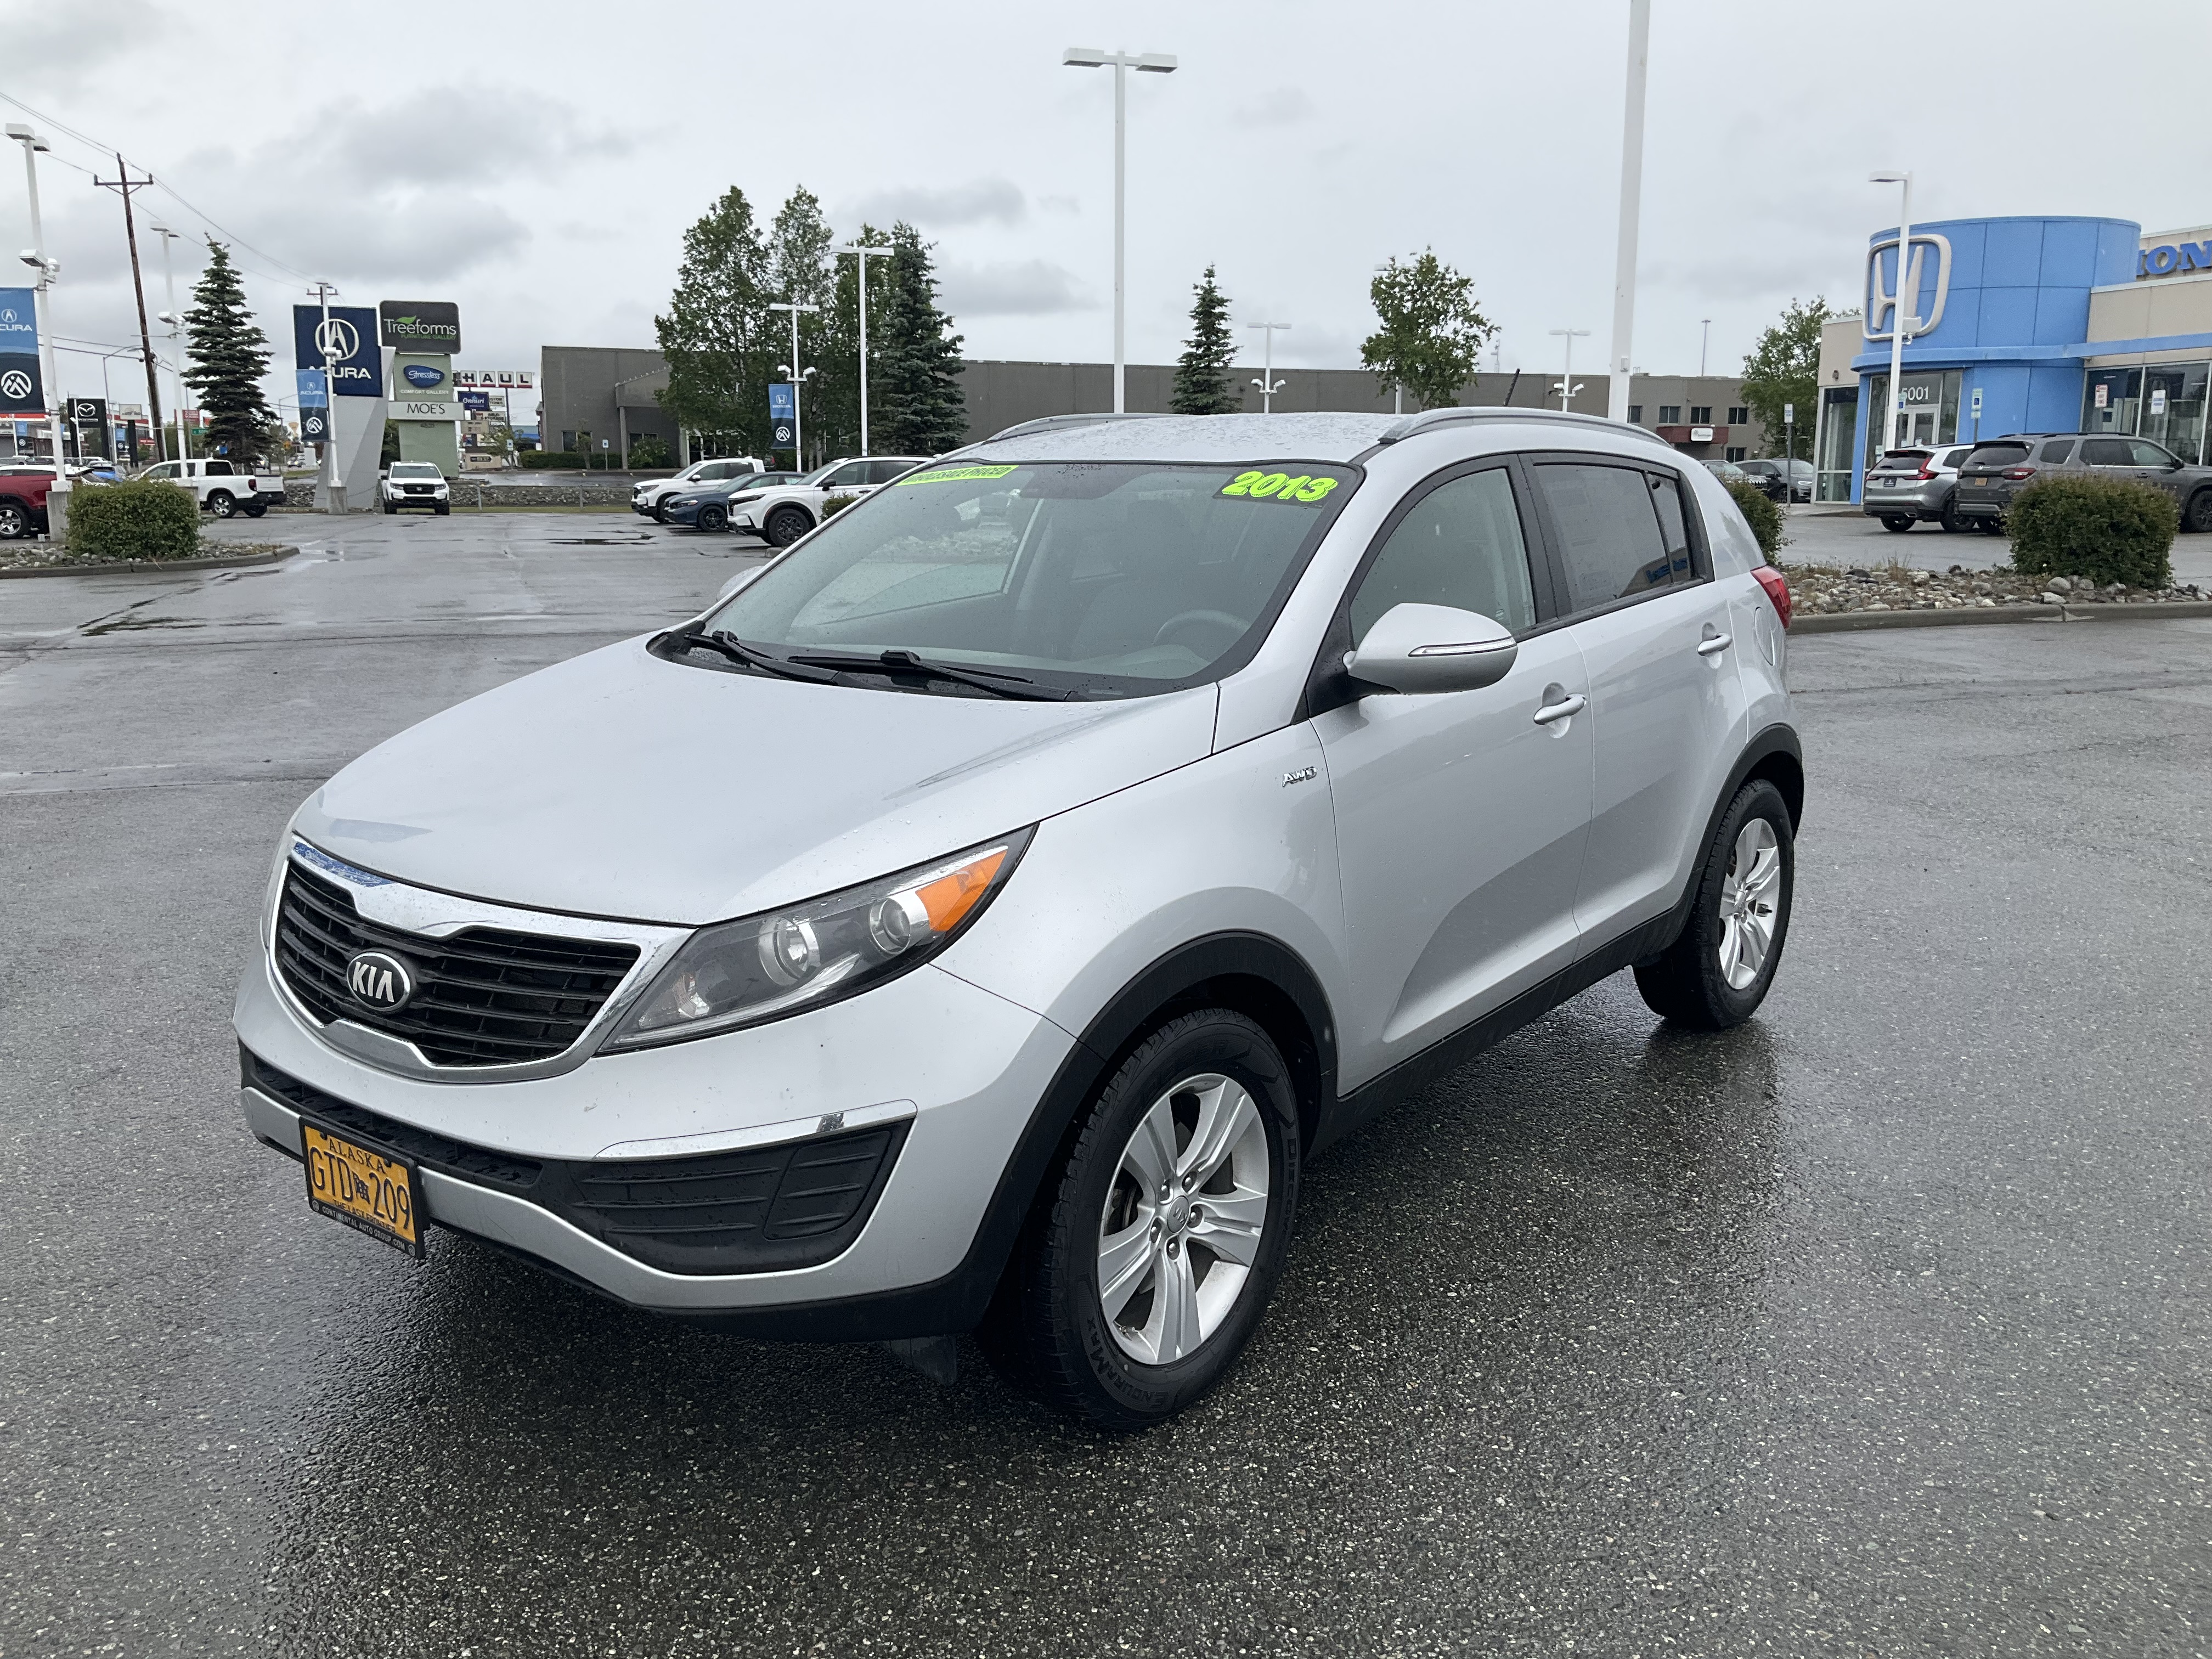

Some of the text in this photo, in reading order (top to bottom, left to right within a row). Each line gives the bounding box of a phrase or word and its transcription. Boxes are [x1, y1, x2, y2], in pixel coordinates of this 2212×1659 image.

[384, 319, 456, 335] Treeforms
[308, 366, 372, 379] URA
[408, 370, 441, 380] Stressless
[1901, 386, 1929, 400] 5001
[407, 403, 445, 414] MOE'S
[1222, 471, 1338, 502] 2013
[1282, 766, 1317, 787] AWD
[353, 961, 394, 1002] KIA
[329, 1138, 386, 1175] ALASKA
[309, 1147, 410, 1230] GTD 209
[322, 1206, 359, 1228] CONTINENTAL
[359, 1222, 373, 1234] AUTO
